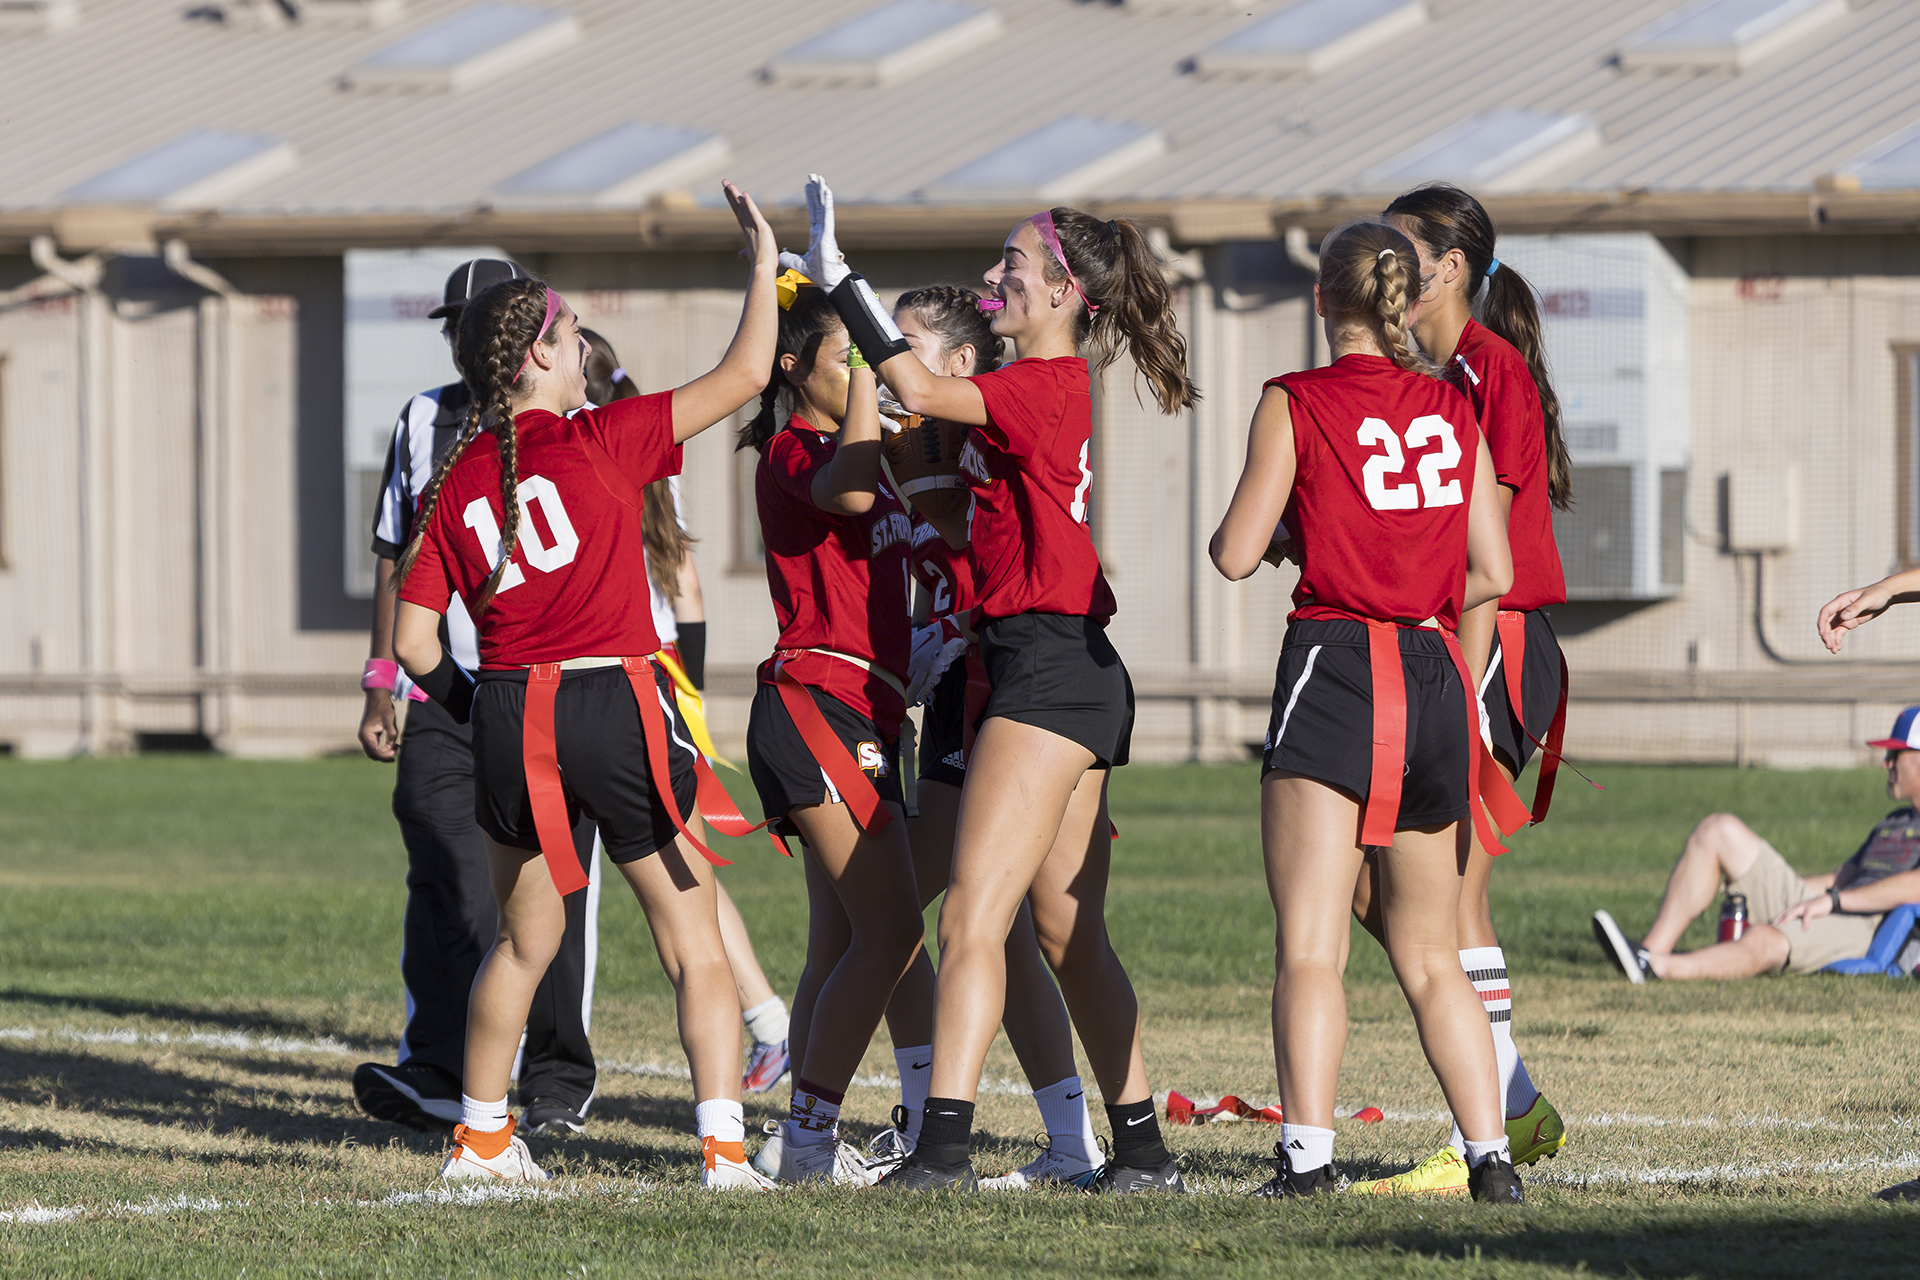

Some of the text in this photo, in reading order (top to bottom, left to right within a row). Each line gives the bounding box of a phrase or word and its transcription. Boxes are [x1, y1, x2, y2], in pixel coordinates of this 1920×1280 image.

[958, 441, 990, 483] NCIS
[1357, 414, 1464, 510] 22
[463, 474, 580, 594] 10
[922, 560, 950, 612] 2
[942, 756, 966, 771] adida
